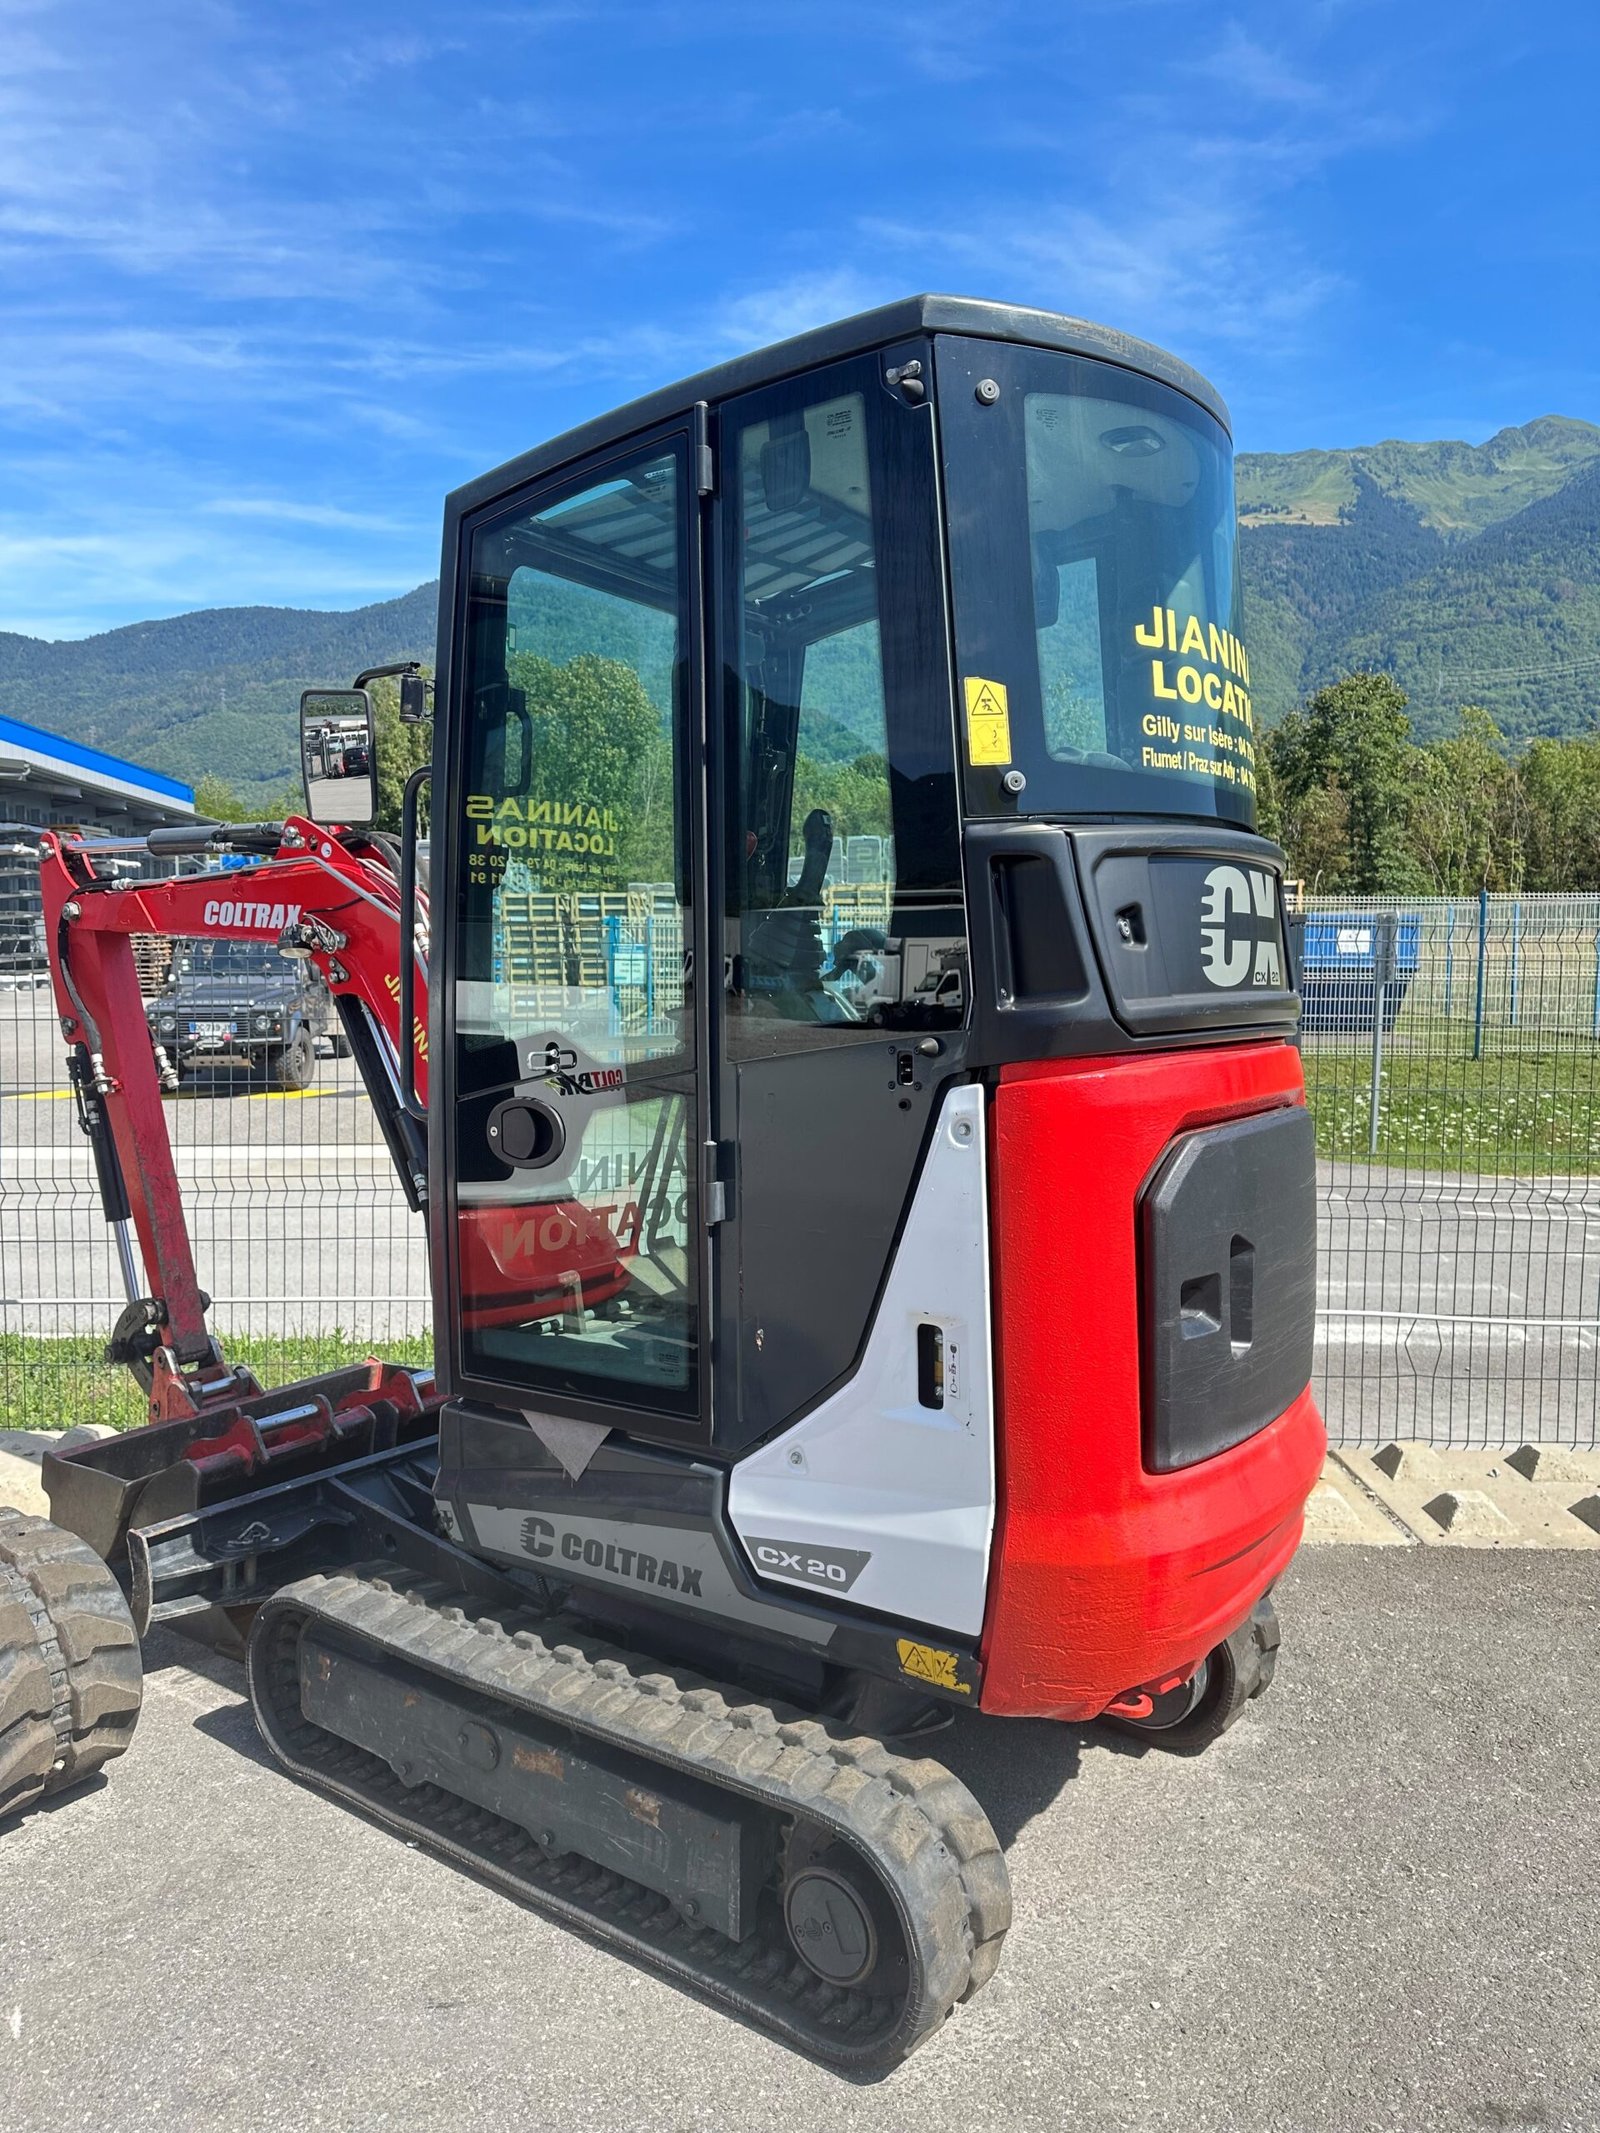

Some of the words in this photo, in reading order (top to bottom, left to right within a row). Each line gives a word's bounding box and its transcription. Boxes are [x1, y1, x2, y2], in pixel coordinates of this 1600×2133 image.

[1142, 714, 1181, 743] Gilly
[1184, 724, 1206, 743] sur
[1208, 725, 1233, 751] Isère
[1142, 746, 1182, 770] Flumet
[1188, 752, 1209, 774] Praz
[1210, 760, 1222, 776] sur
[204, 900, 303, 930] COLTRAX
[1255, 971, 1266, 982] CX
[561, 1531, 703, 1598] COLTRAX
[757, 1545, 803, 1573] CX
[807, 1558, 847, 1584] 20
